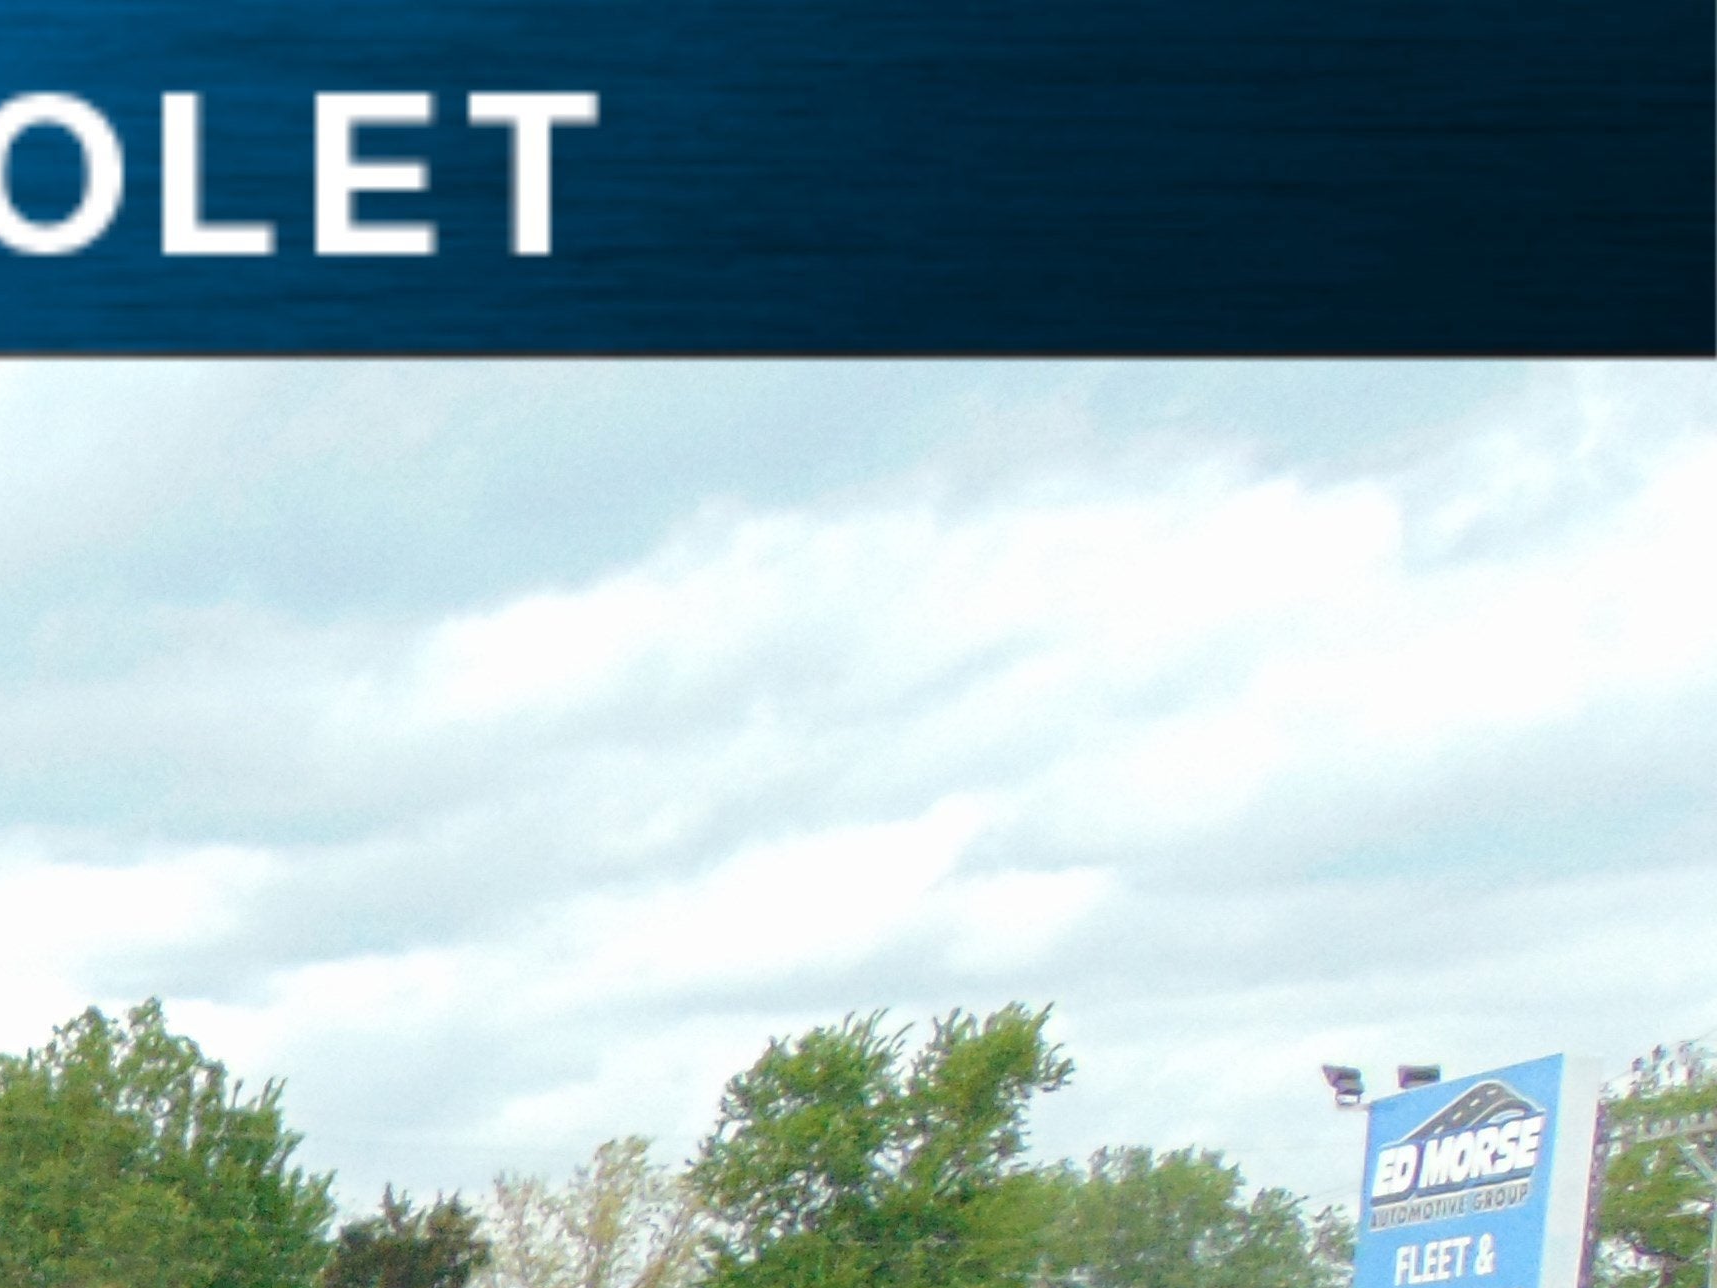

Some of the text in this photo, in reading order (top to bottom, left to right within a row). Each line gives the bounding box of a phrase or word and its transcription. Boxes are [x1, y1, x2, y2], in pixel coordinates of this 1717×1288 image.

[1371, 1116, 1545, 1198] ED MORSE
[1370, 1183, 1529, 1229] AUTOMOTIVE GROUP
[1394, 1232, 1497, 1287] FLEET &
